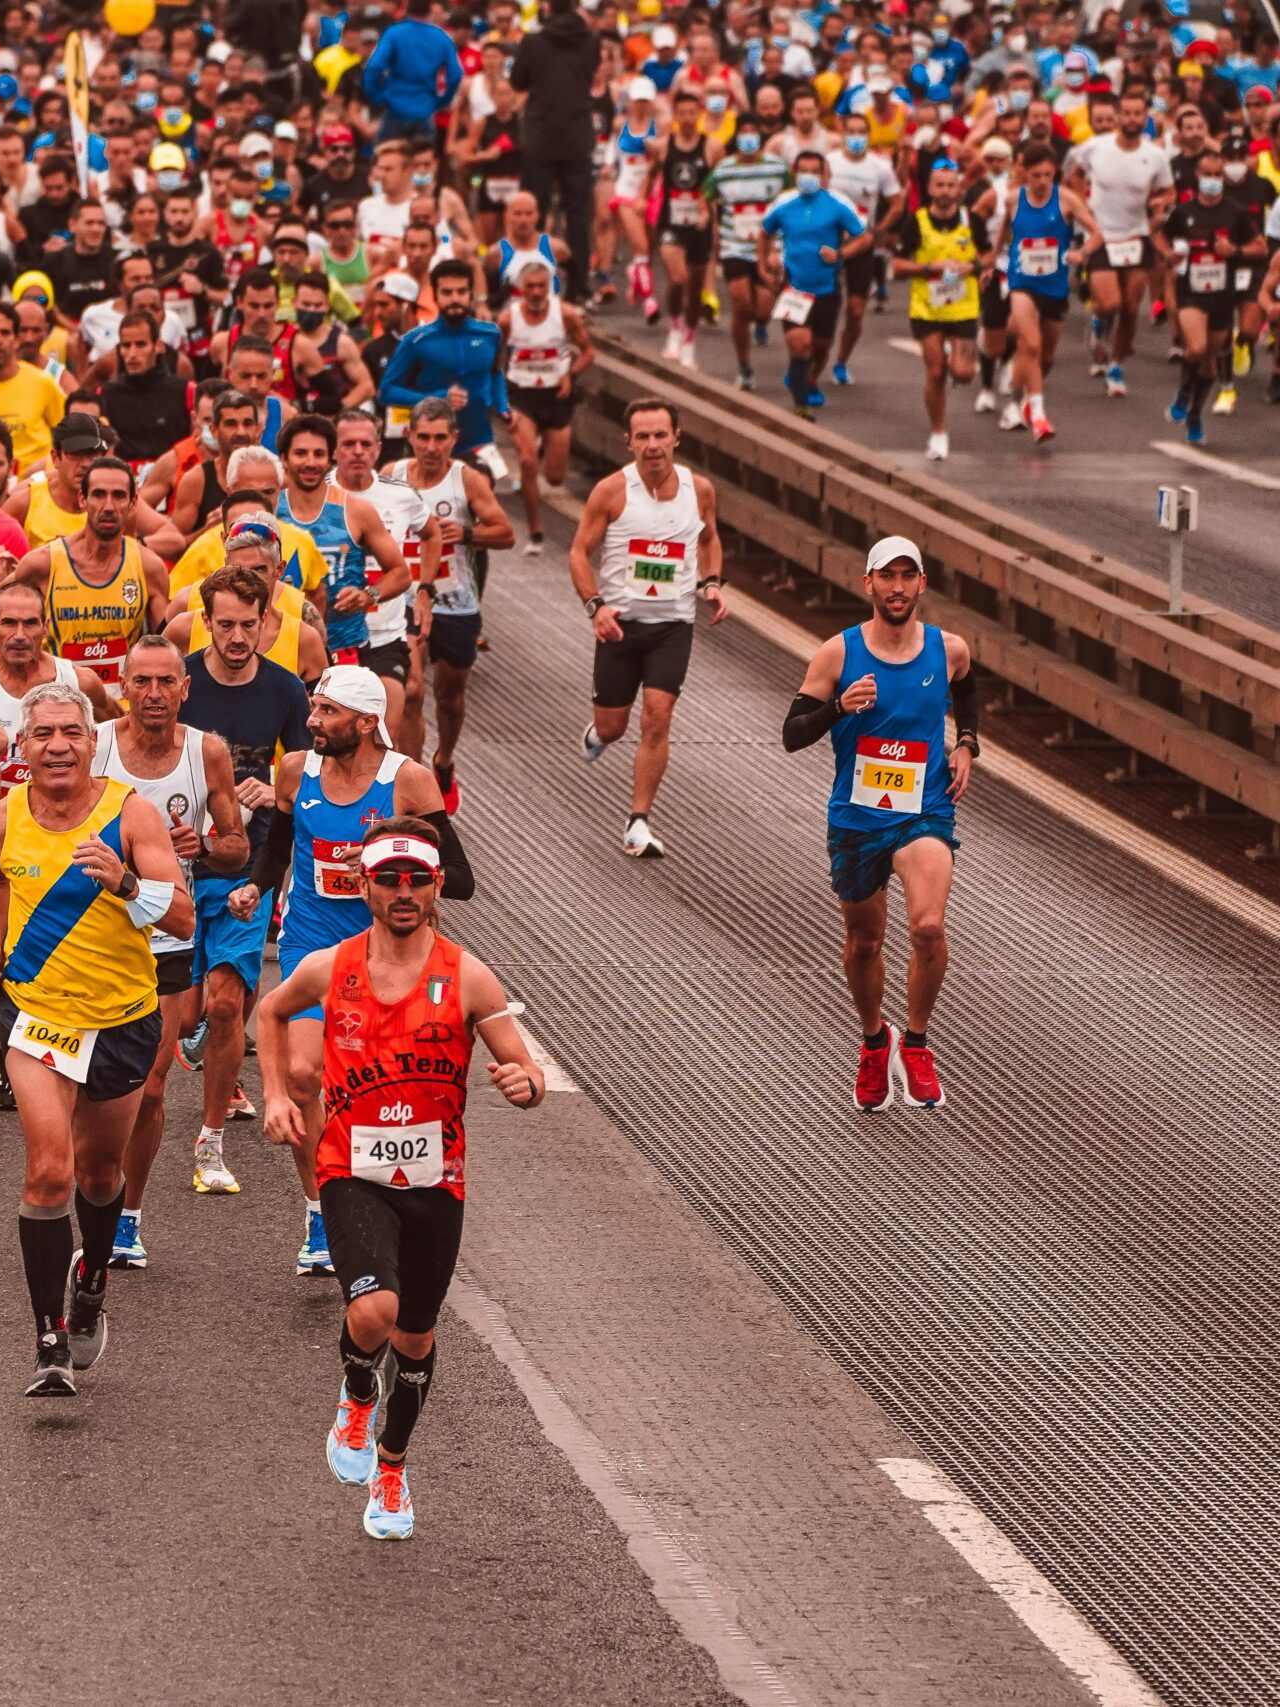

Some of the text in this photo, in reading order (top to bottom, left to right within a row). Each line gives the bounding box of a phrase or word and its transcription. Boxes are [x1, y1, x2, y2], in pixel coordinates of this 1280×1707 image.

[647, 543, 669, 558] edp
[84, 643, 108, 658] edp
[879, 741, 907, 761] edp
[874, 771, 904, 788] 178
[27, 1024, 81, 1054] 10410
[346, 1059, 389, 1090] dei
[379, 1100, 414, 1126] edp
[370, 1137, 429, 1161] 4902
